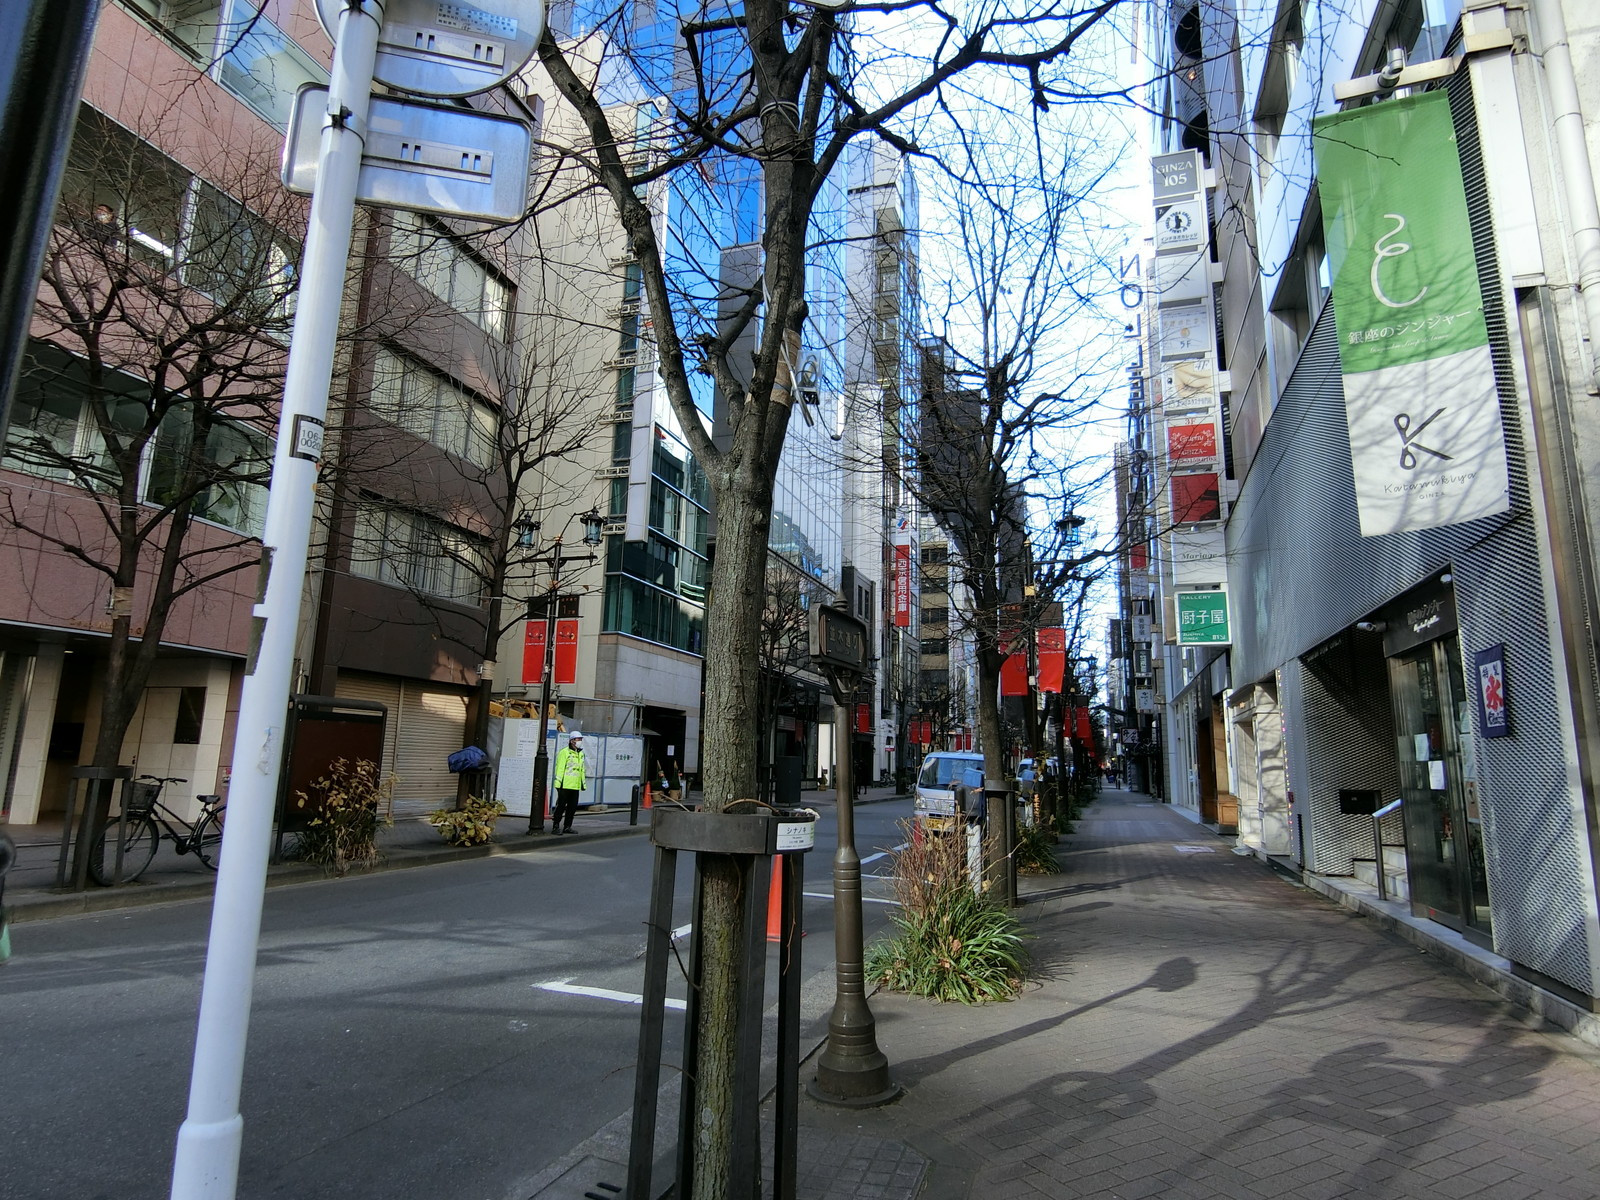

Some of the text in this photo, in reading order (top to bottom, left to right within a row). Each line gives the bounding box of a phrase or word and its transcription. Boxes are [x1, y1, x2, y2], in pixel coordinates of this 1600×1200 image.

[1156, 161, 1193, 174] GINZA
[1164, 173, 1187, 187] 105
[1348, 310, 1471, 345] 銀座のジンジャー
[1181, 609, 1225, 625] 厨子屋
[787, 826, 806, 835] シナノキ
